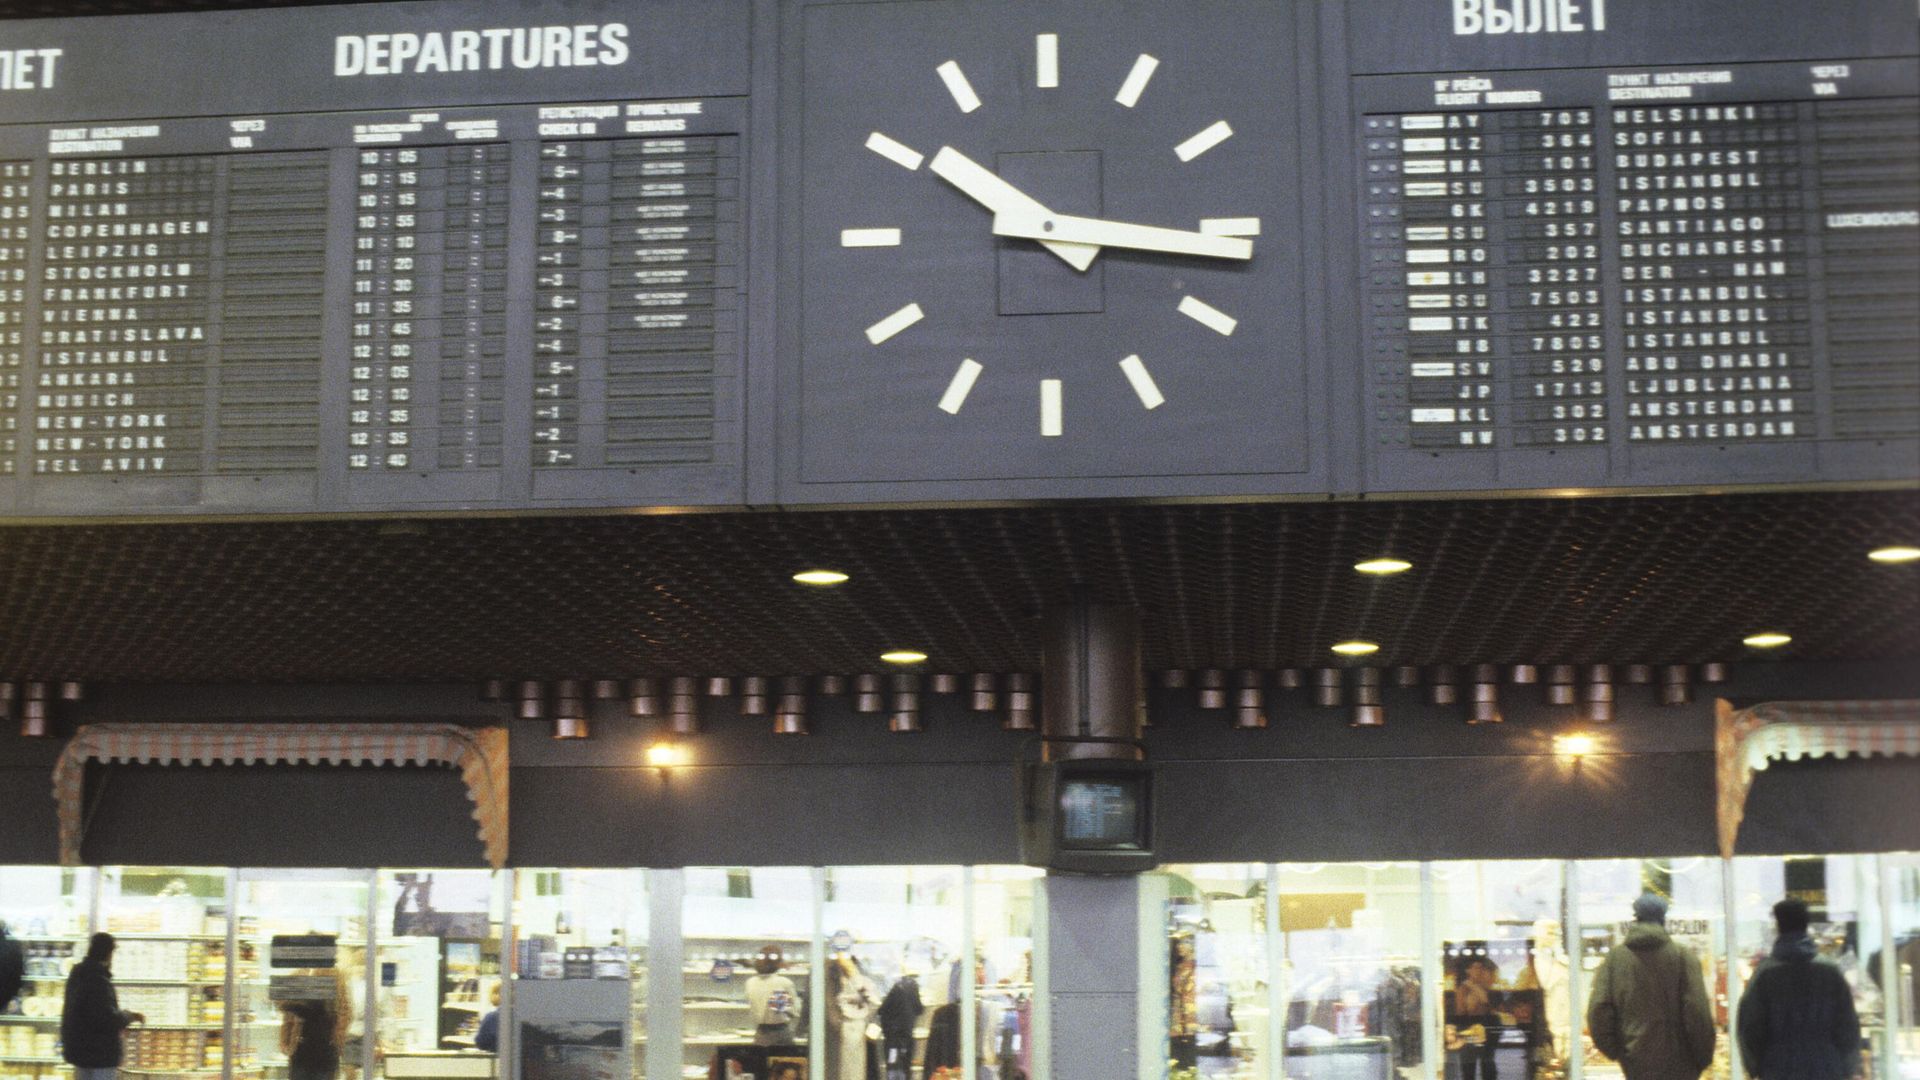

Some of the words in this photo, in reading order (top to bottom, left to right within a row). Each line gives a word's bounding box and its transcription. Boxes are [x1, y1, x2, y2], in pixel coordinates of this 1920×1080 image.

[335, 23, 629, 76] DEPARTURES
[1448, 115, 1479, 129] AY
[1614, 107, 1754, 123] HELSINKI
[1449, 137, 1480, 150] LZ
[1616, 131, 1702, 145] SOFIA
[1616, 151, 1758, 167] BUDAPEST
[52, 161, 146, 175] BERLIN
[51, 182, 128, 196] PARIS
[1620, 173, 1759, 190] ISTANBUL
[49, 204, 126, 217] MILAN
[48, 221, 208, 237] COPENHAGEN
[1620, 217, 1763, 234] SANTIAGO
[47, 244, 157, 259] LEIPZIG
[1621, 239, 1782, 257] BUCHAREST
[46, 264, 190, 280] STOCKHOLM
[45, 285, 187, 301] FRANKFURT
[1626, 286, 1766, 302] ISTANBUL
[44, 308, 137, 322] VIENNA
[1550, 313, 1599, 326] 422
[1627, 308, 1767, 325] ISTANBUL
[1456, 317, 1488, 330] TK
[42, 327, 202, 343] BRATISLAVA
[1628, 331, 1768, 347] ISTANBUL
[43, 350, 168, 364] ISTANBUL
[1627, 357, 1677, 370] ABU
[1701, 353, 1786, 368] DHABI
[40, 373, 133, 385] ANKARA
[1629, 376, 1790, 393] LJUBLJANA
[38, 394, 133, 407] MUNICH
[1630, 399, 1792, 416] AMSTERDAM
[38, 414, 165, 428] NEW-YORK
[1459, 408, 1490, 421] KL
[1631, 422, 1794, 439] AMSTERDAM
[37, 436, 164, 450] NEW-YORK
[37, 459, 80, 472] TEL
[102, 458, 164, 470] AVIV
